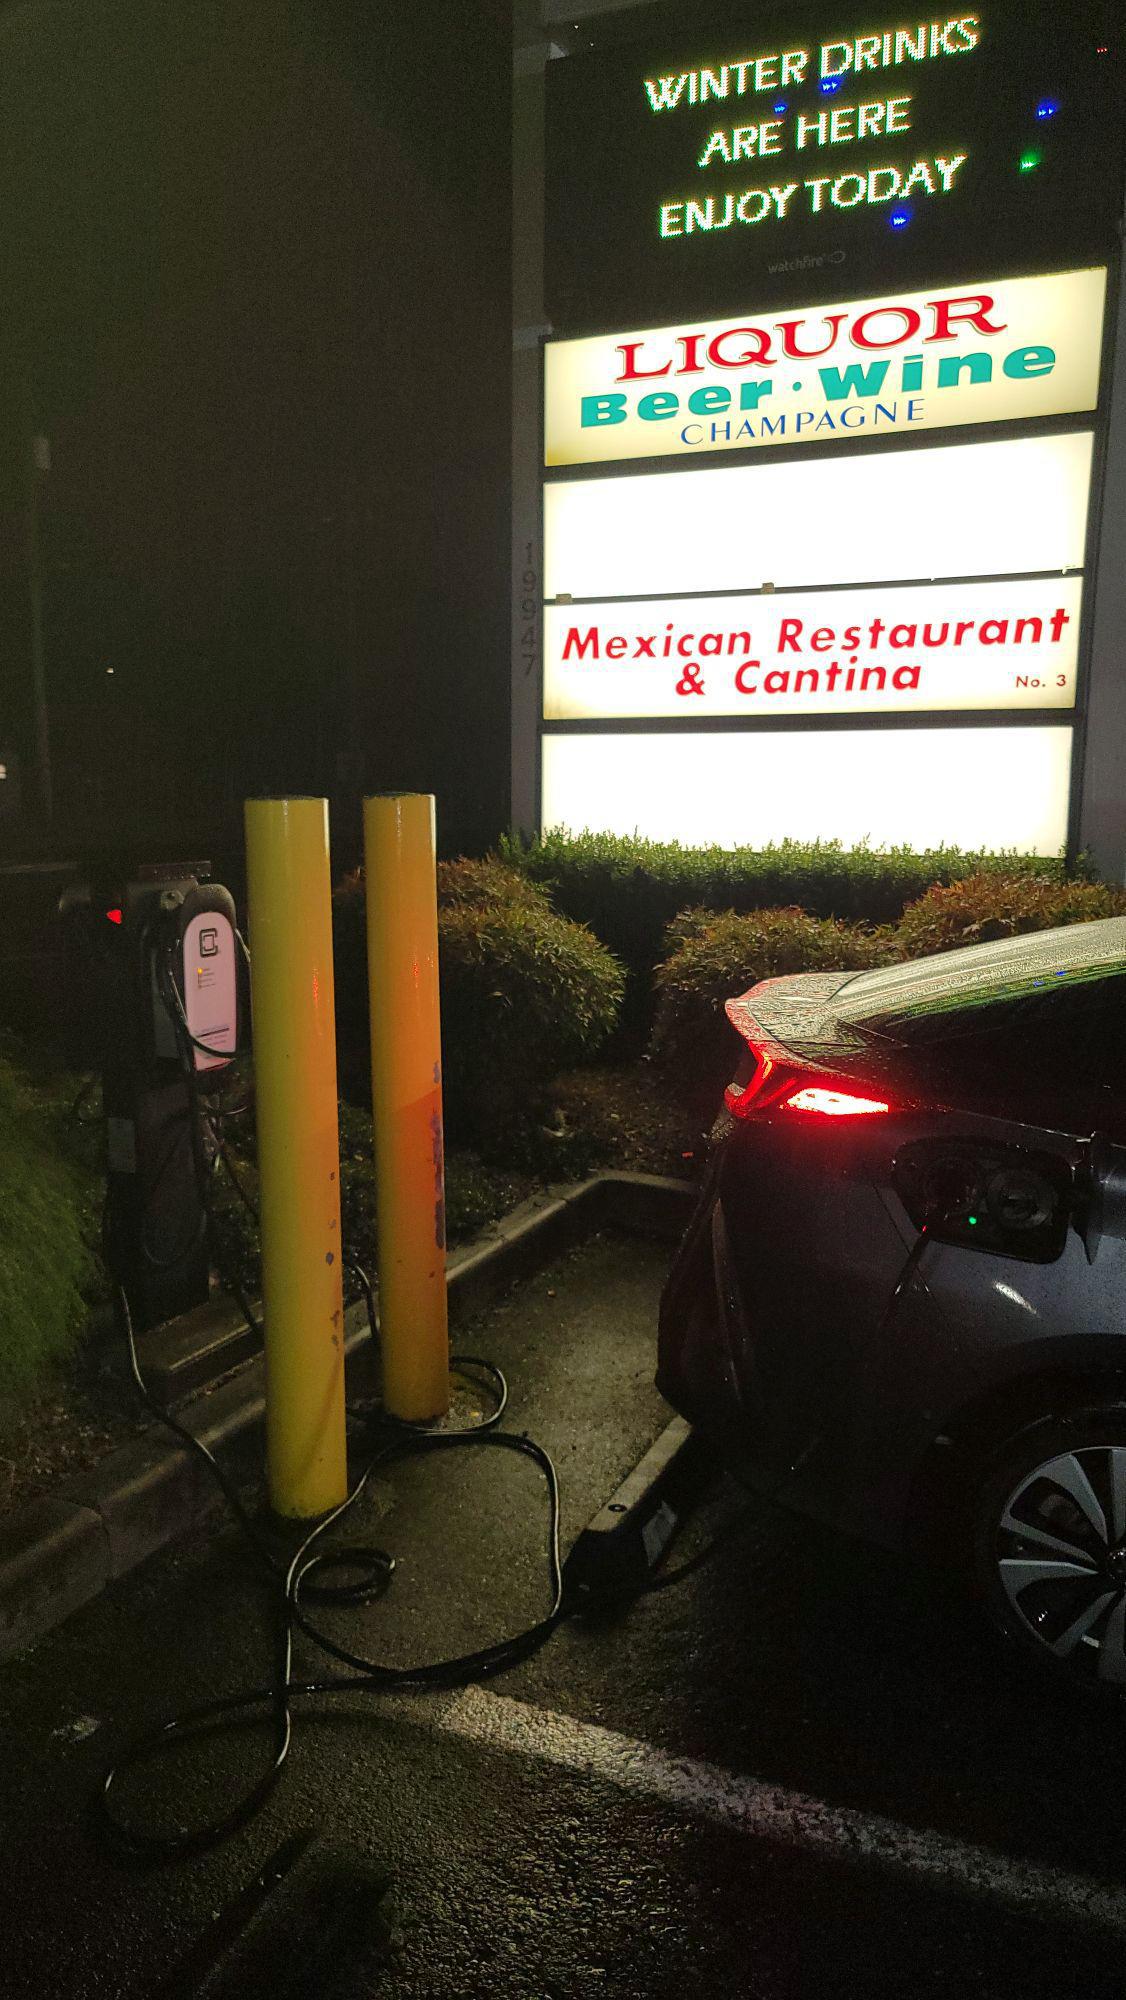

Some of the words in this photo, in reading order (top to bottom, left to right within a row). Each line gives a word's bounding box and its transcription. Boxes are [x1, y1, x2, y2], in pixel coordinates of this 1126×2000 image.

[644, 51, 808, 112] WINTER
[819, 17, 980, 79] DRINKS
[698, 119, 783, 167] ARE
[796, 96, 912, 150] HERE
[659, 182, 797, 238] ENJOY
[804, 155, 969, 212] TODAY
[615, 294, 1007, 382] LIQUOR
[580, 379, 773, 428] Beer
[681, 398, 925, 446] CHAMPAGNE
[561, 624, 751, 661] Mexican
[777, 608, 1070, 655] Restaurant
[675, 664, 705, 696] &
[734, 656, 922, 695] Cantina
[1015, 675, 1046, 690] No.
[1056, 674, 1068, 688] 3
